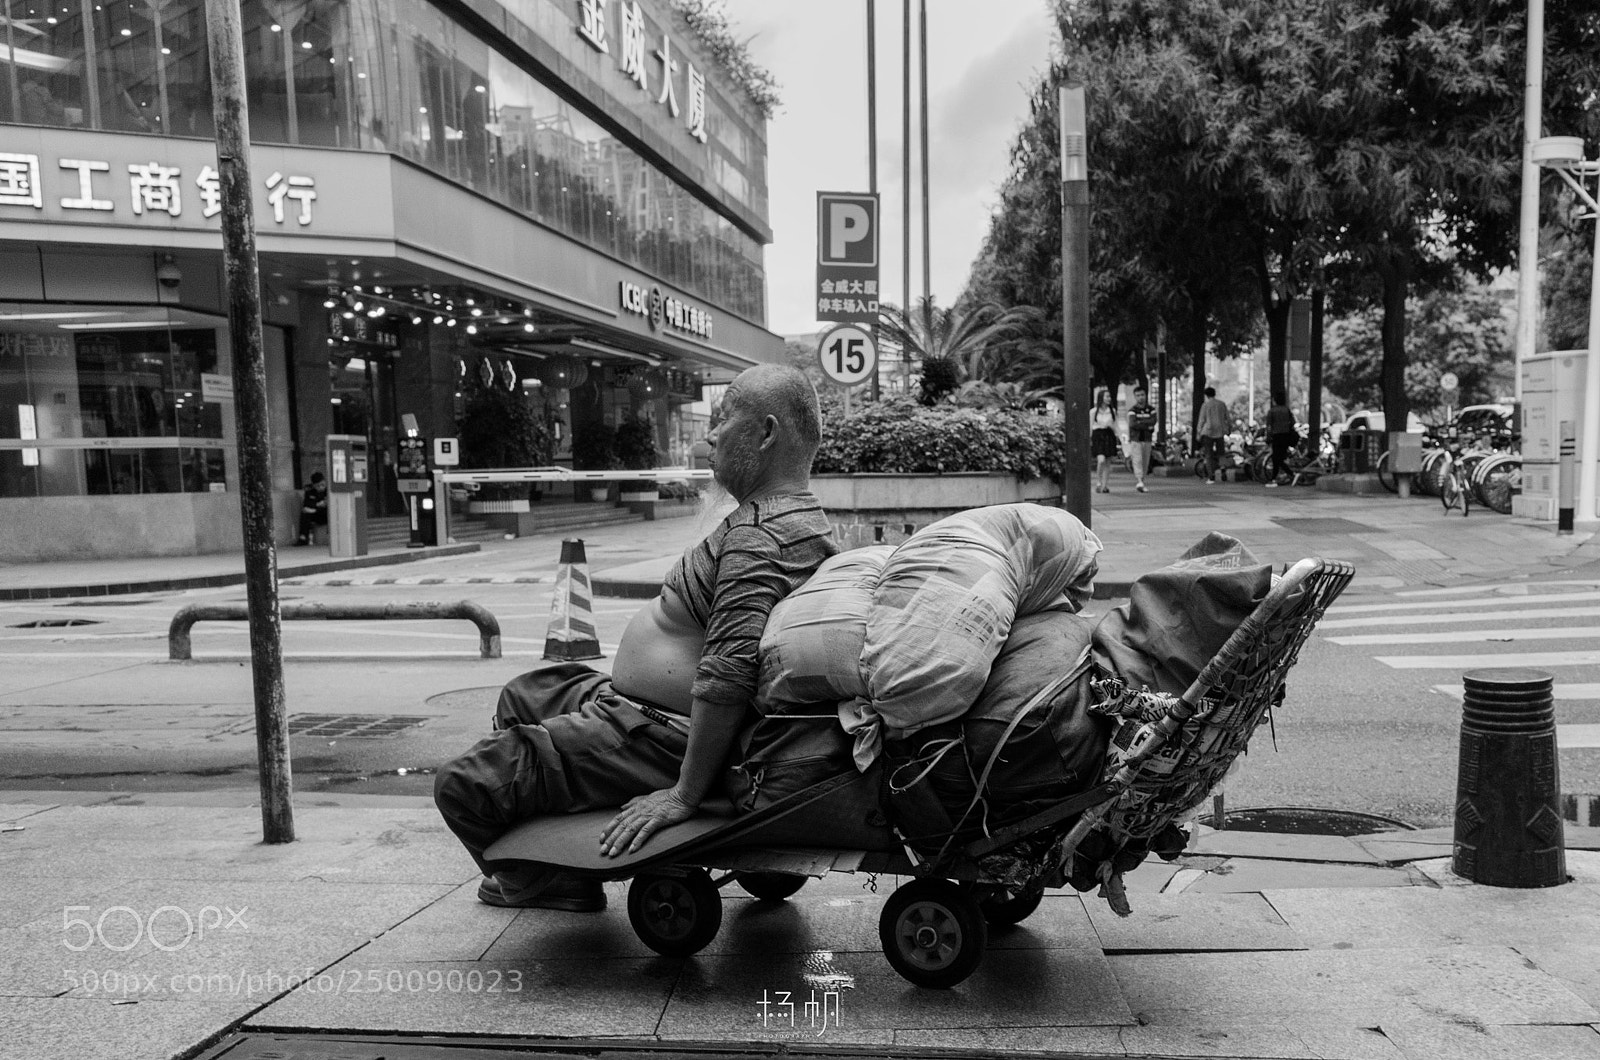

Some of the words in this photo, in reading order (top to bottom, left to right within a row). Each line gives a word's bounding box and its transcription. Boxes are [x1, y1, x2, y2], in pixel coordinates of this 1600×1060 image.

[830, 202, 870, 259] P
[621, 280, 650, 317] ICBC
[821, 278, 878, 295] 金威大厦
[818, 298, 879, 313] 停车场入口
[829, 338, 866, 374] 15
